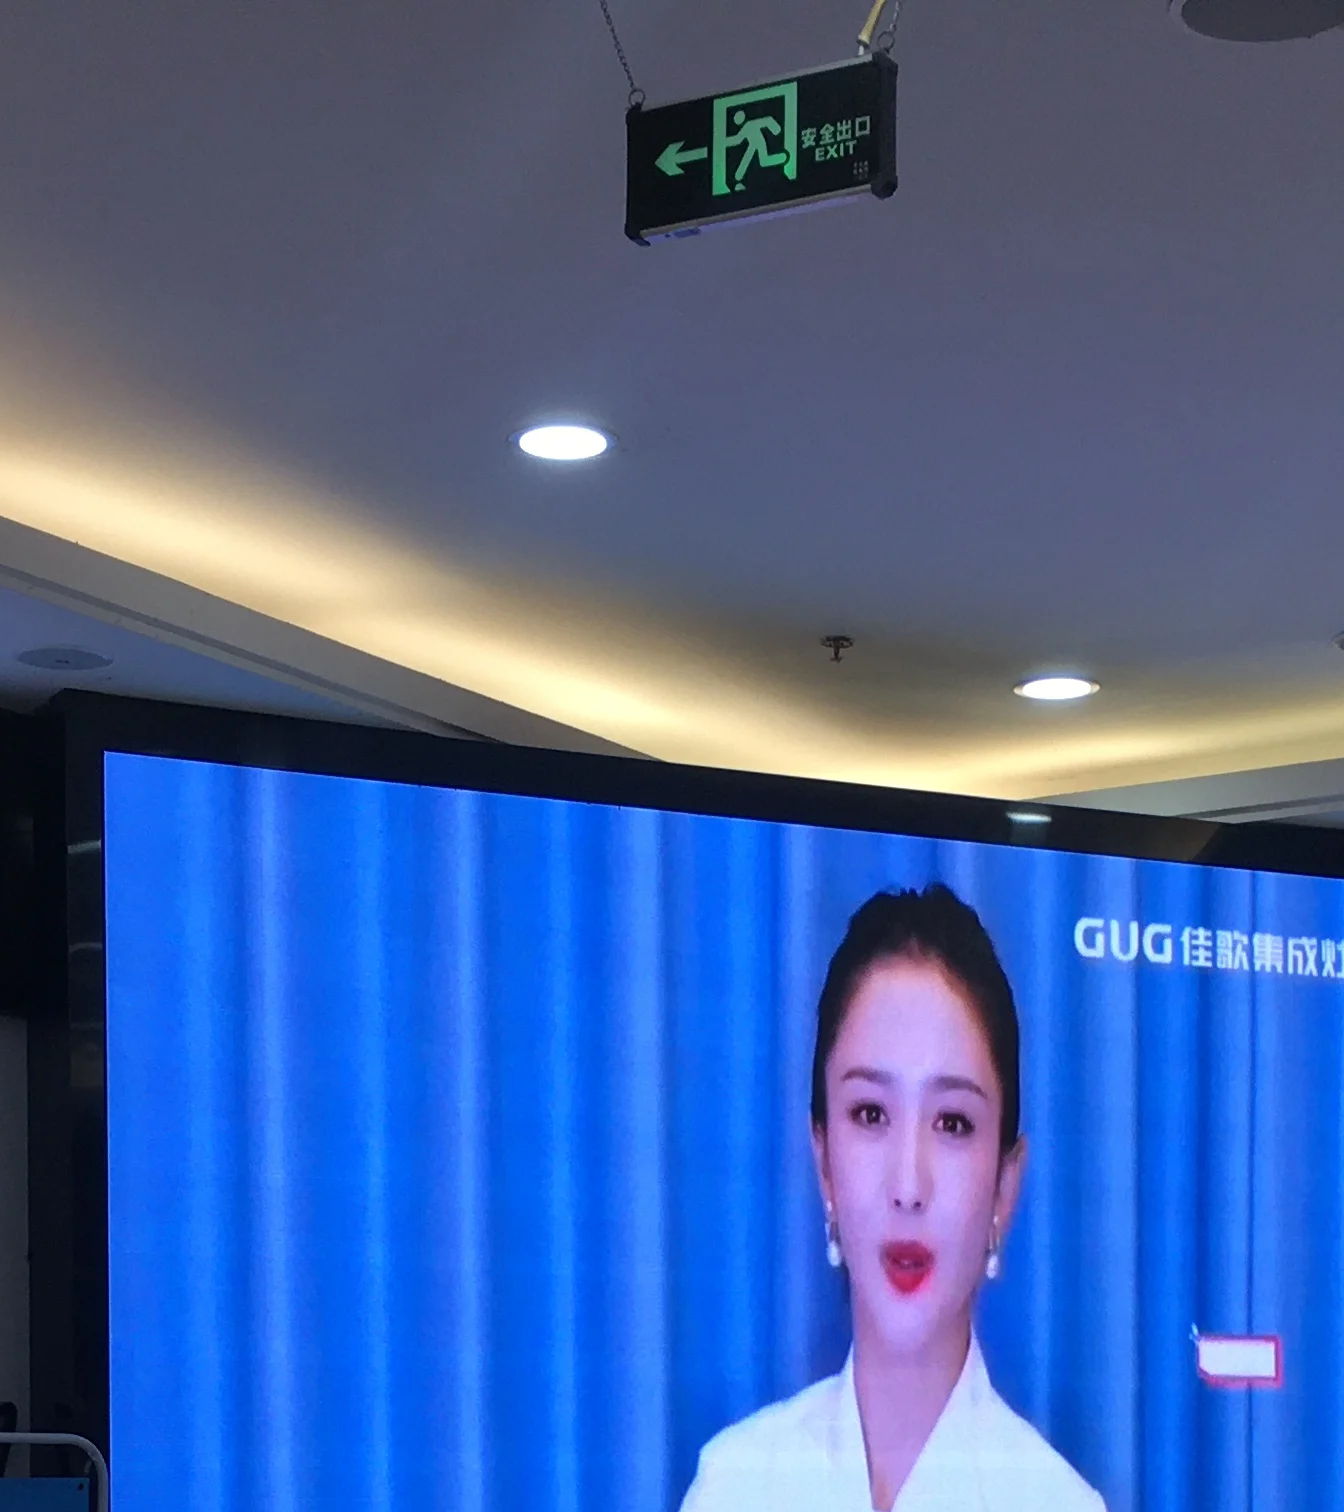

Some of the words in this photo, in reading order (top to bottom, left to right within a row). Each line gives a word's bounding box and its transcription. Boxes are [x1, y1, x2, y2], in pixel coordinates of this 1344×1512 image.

[801, 115, 870, 148] 安全出口
[815, 140, 857, 161] EXIT
[1074, 917, 1172, 963] GUG
